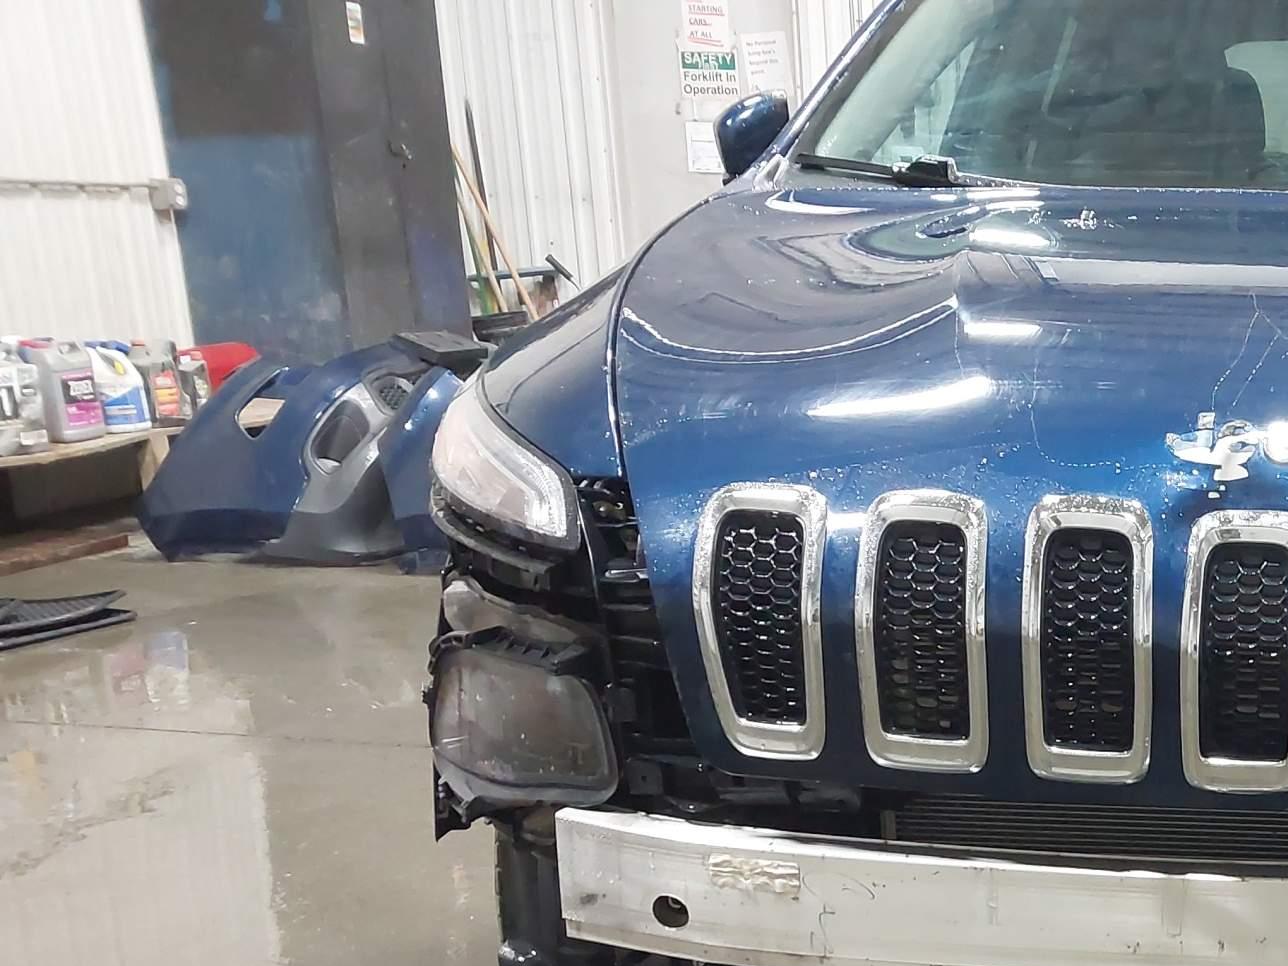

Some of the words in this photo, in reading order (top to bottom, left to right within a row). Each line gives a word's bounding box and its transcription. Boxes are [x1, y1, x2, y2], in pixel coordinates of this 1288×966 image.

[688, 4, 723, 13] STARTING
[684, 52, 731, 65] SAFETY
[683, 71, 723, 82] Forklift
[726, 71, 736, 82] In
[683, 84, 738, 96] Operation
